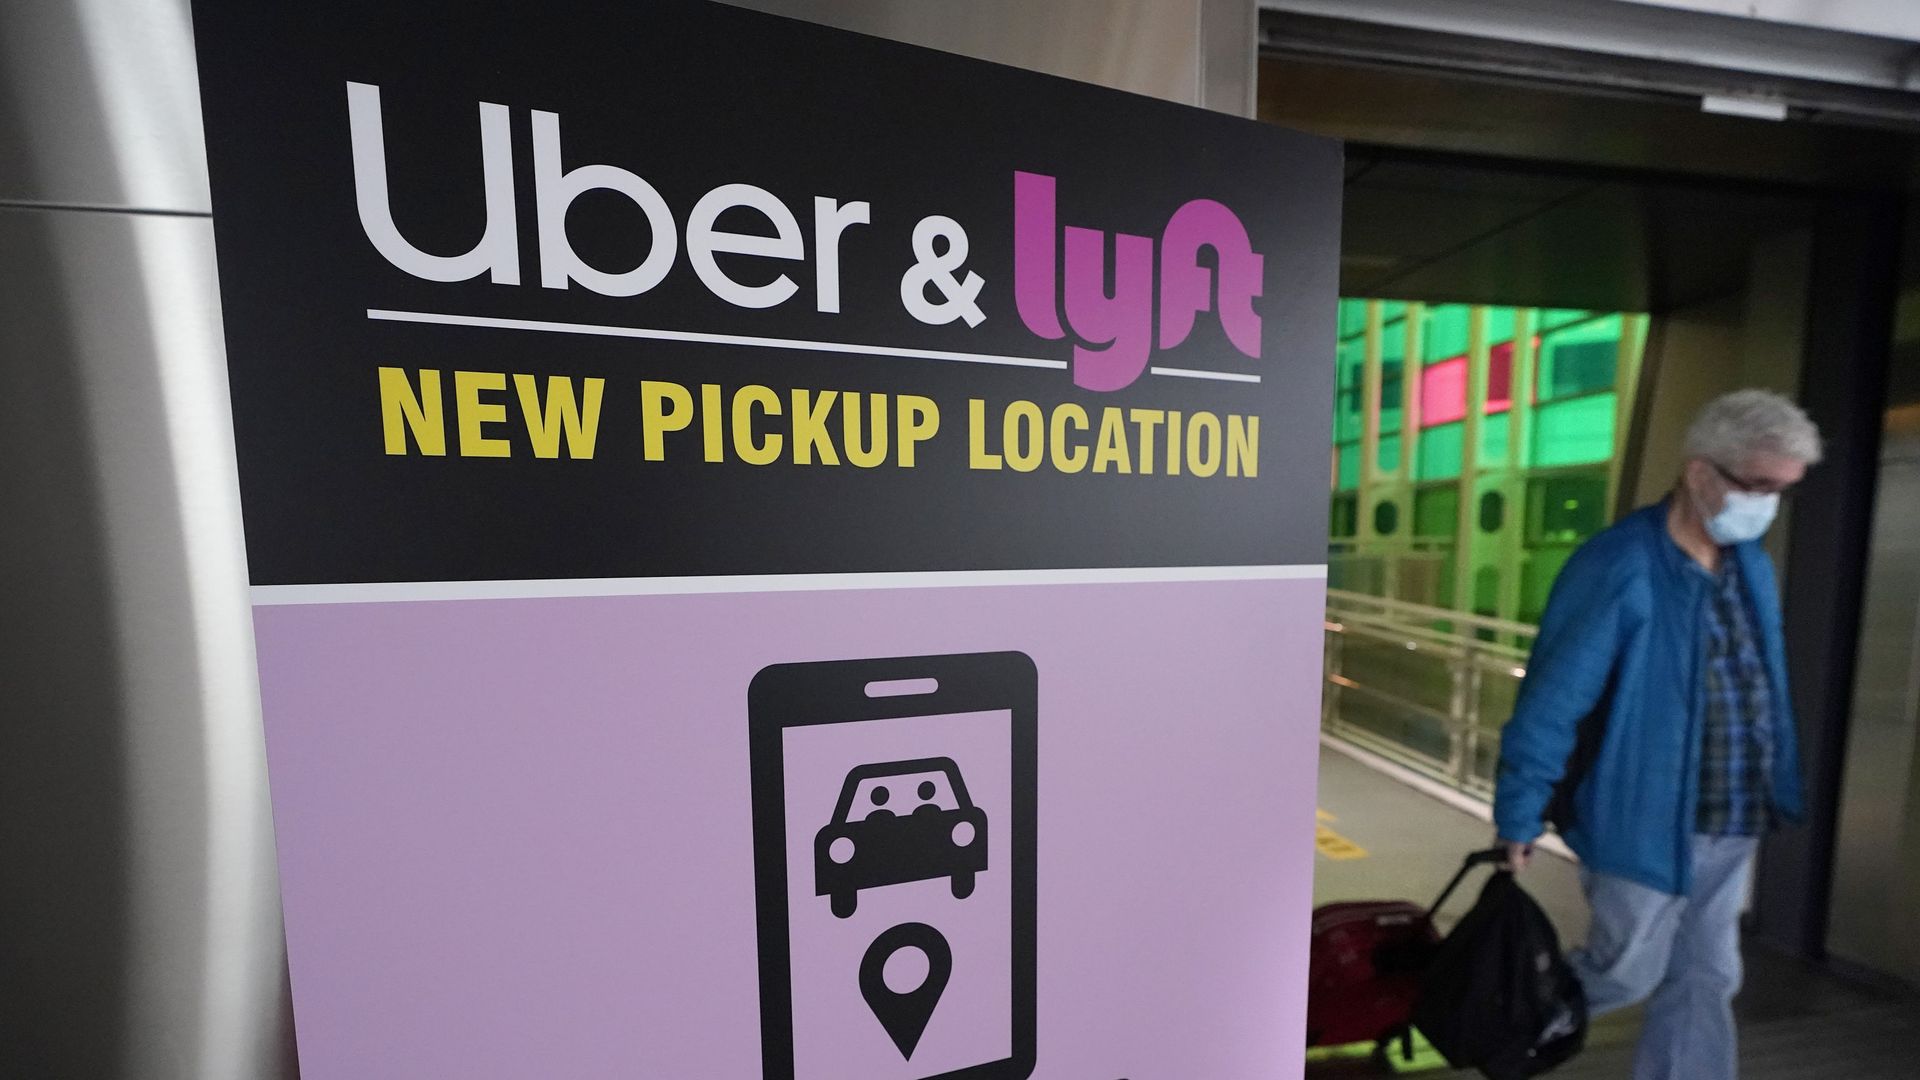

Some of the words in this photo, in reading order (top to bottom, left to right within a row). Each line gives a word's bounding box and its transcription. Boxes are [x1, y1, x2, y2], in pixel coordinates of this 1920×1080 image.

[346, 80, 871, 314] Uber
[900, 215, 987, 329] &
[1014, 170, 1265, 391] lyft
[378, 366, 606, 460] NEW
[640, 380, 940, 468] PICKUP
[968, 399, 1260, 478] LOCATION
